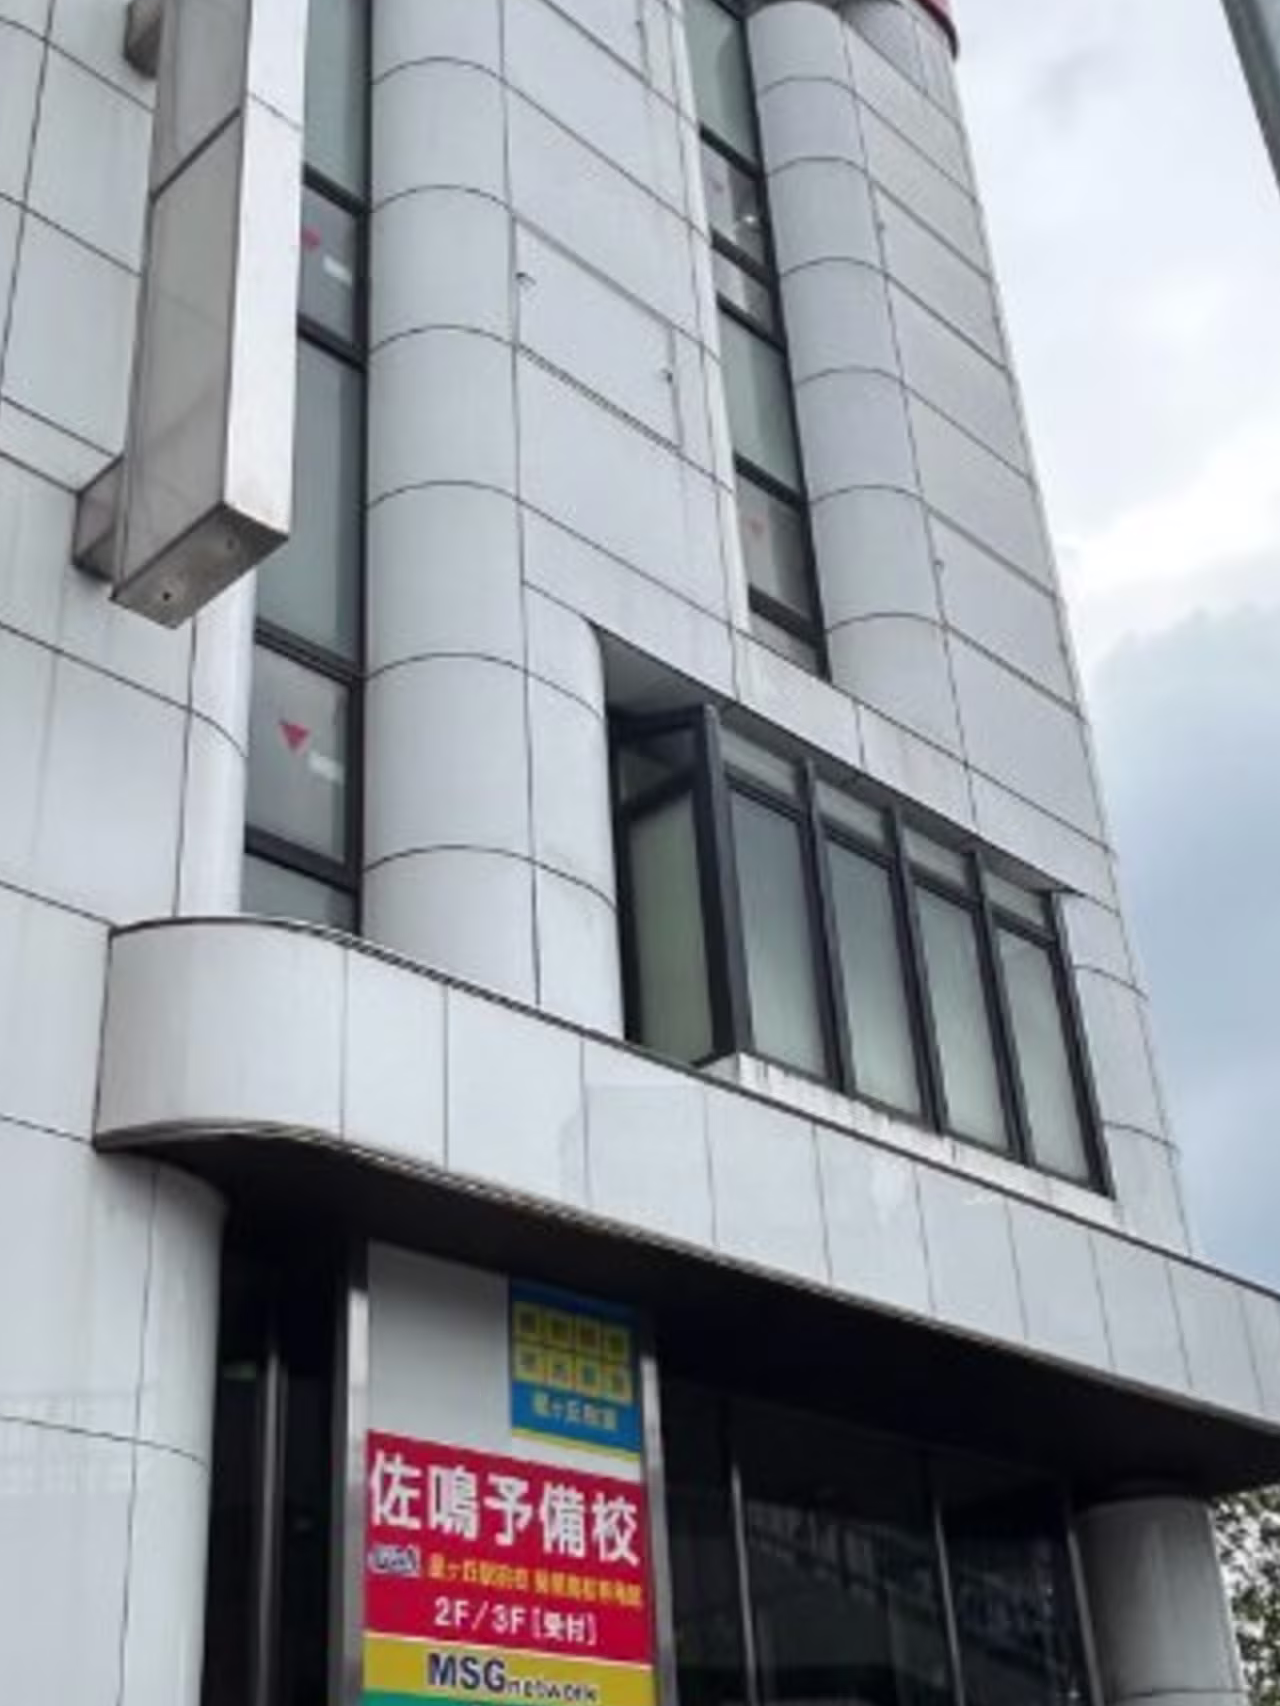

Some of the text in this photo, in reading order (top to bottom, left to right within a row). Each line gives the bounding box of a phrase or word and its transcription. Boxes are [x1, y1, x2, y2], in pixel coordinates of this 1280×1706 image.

[370, 1449, 640, 1566] 佐鳴予備校
